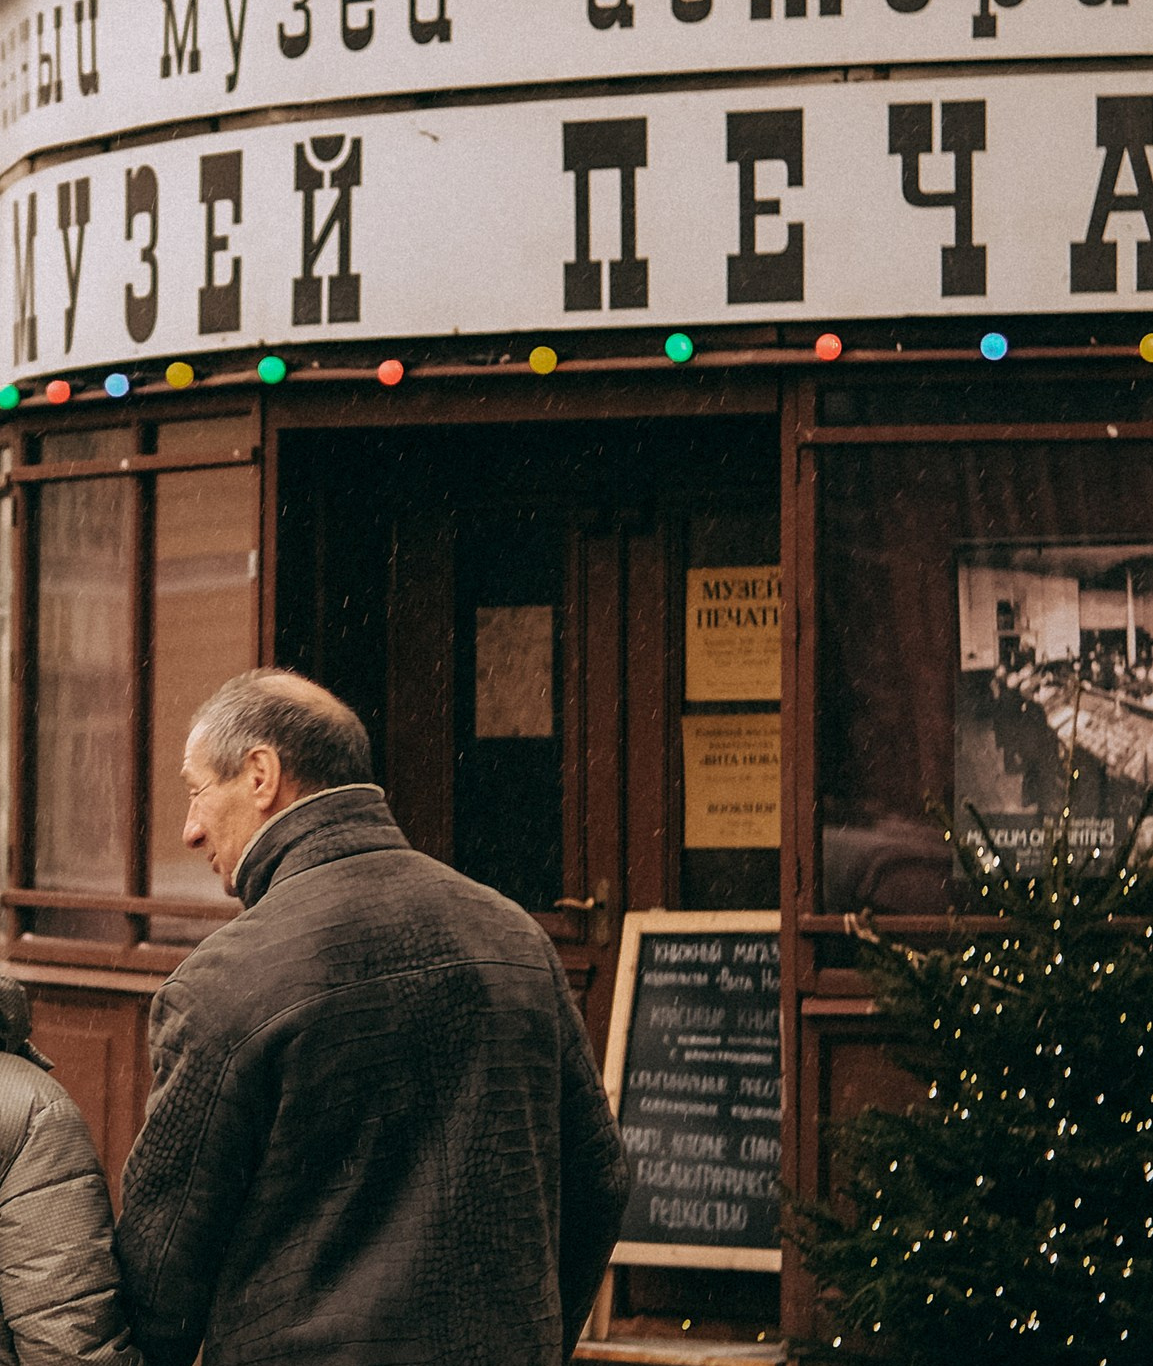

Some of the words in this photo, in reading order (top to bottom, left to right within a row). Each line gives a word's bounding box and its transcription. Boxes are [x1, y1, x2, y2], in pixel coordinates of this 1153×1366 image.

[13, 133, 363, 367] МУЗЕЙ
[562, 95, 1153, 312] ПЕЧА
[702, 572, 782, 600] МУЗЕЙ
